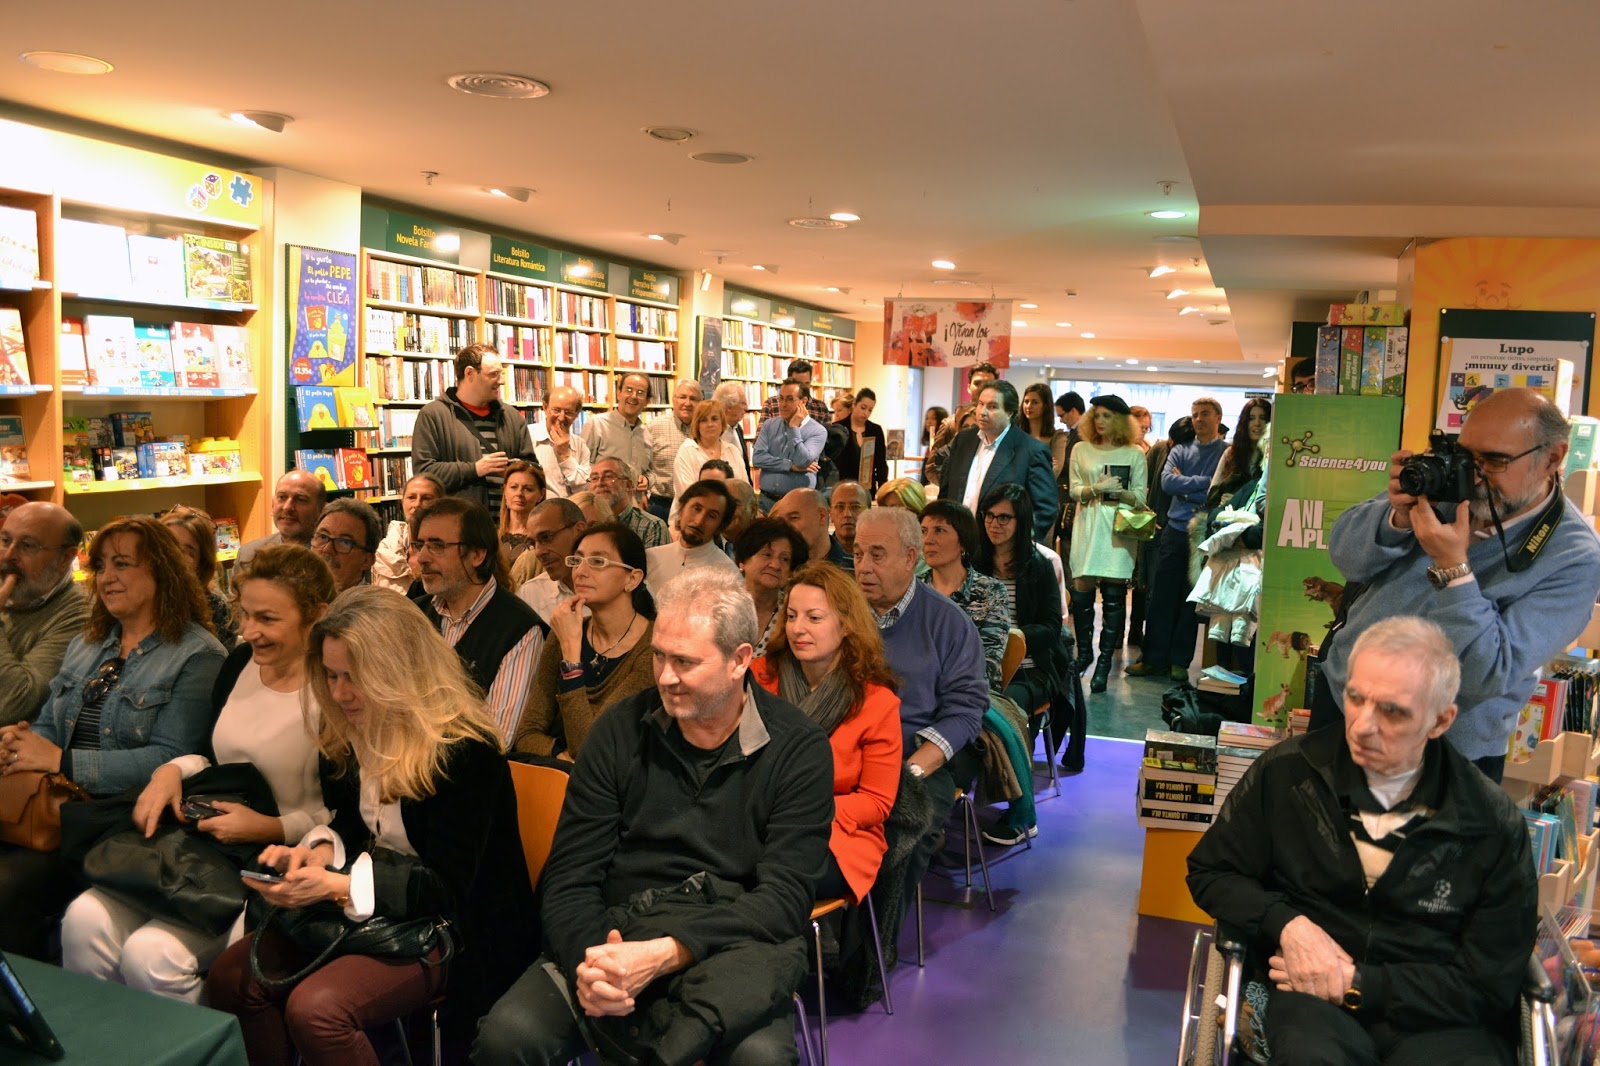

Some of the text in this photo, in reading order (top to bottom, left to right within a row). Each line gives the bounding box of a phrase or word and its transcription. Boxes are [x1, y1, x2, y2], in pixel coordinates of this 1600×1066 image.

[414, 225, 436, 238] Bolsillo
[396, 233, 418, 246] Novela
[511, 246, 530, 258] Bolsillo
[316, 255, 332, 265] gusta
[494, 252, 546, 272] Literatura Romántica
[315, 268, 328, 277] pollo
[329, 265, 351, 280] PEPE
[327, 290, 350, 305] CLEA
[944, 322, 990, 342] ¡Vivan los
[952, 339, 981, 362] libros!
[1500, 344, 1534, 355] Lupo
[1465, 363, 1508, 371] ¡muuuy
[1299, 456, 1387, 472] Science4you
[1526, 523, 1550, 553] Nikon
[1166, 783, 1184, 791] QUINTA
[1162, 811, 1180, 819] QUINTA
